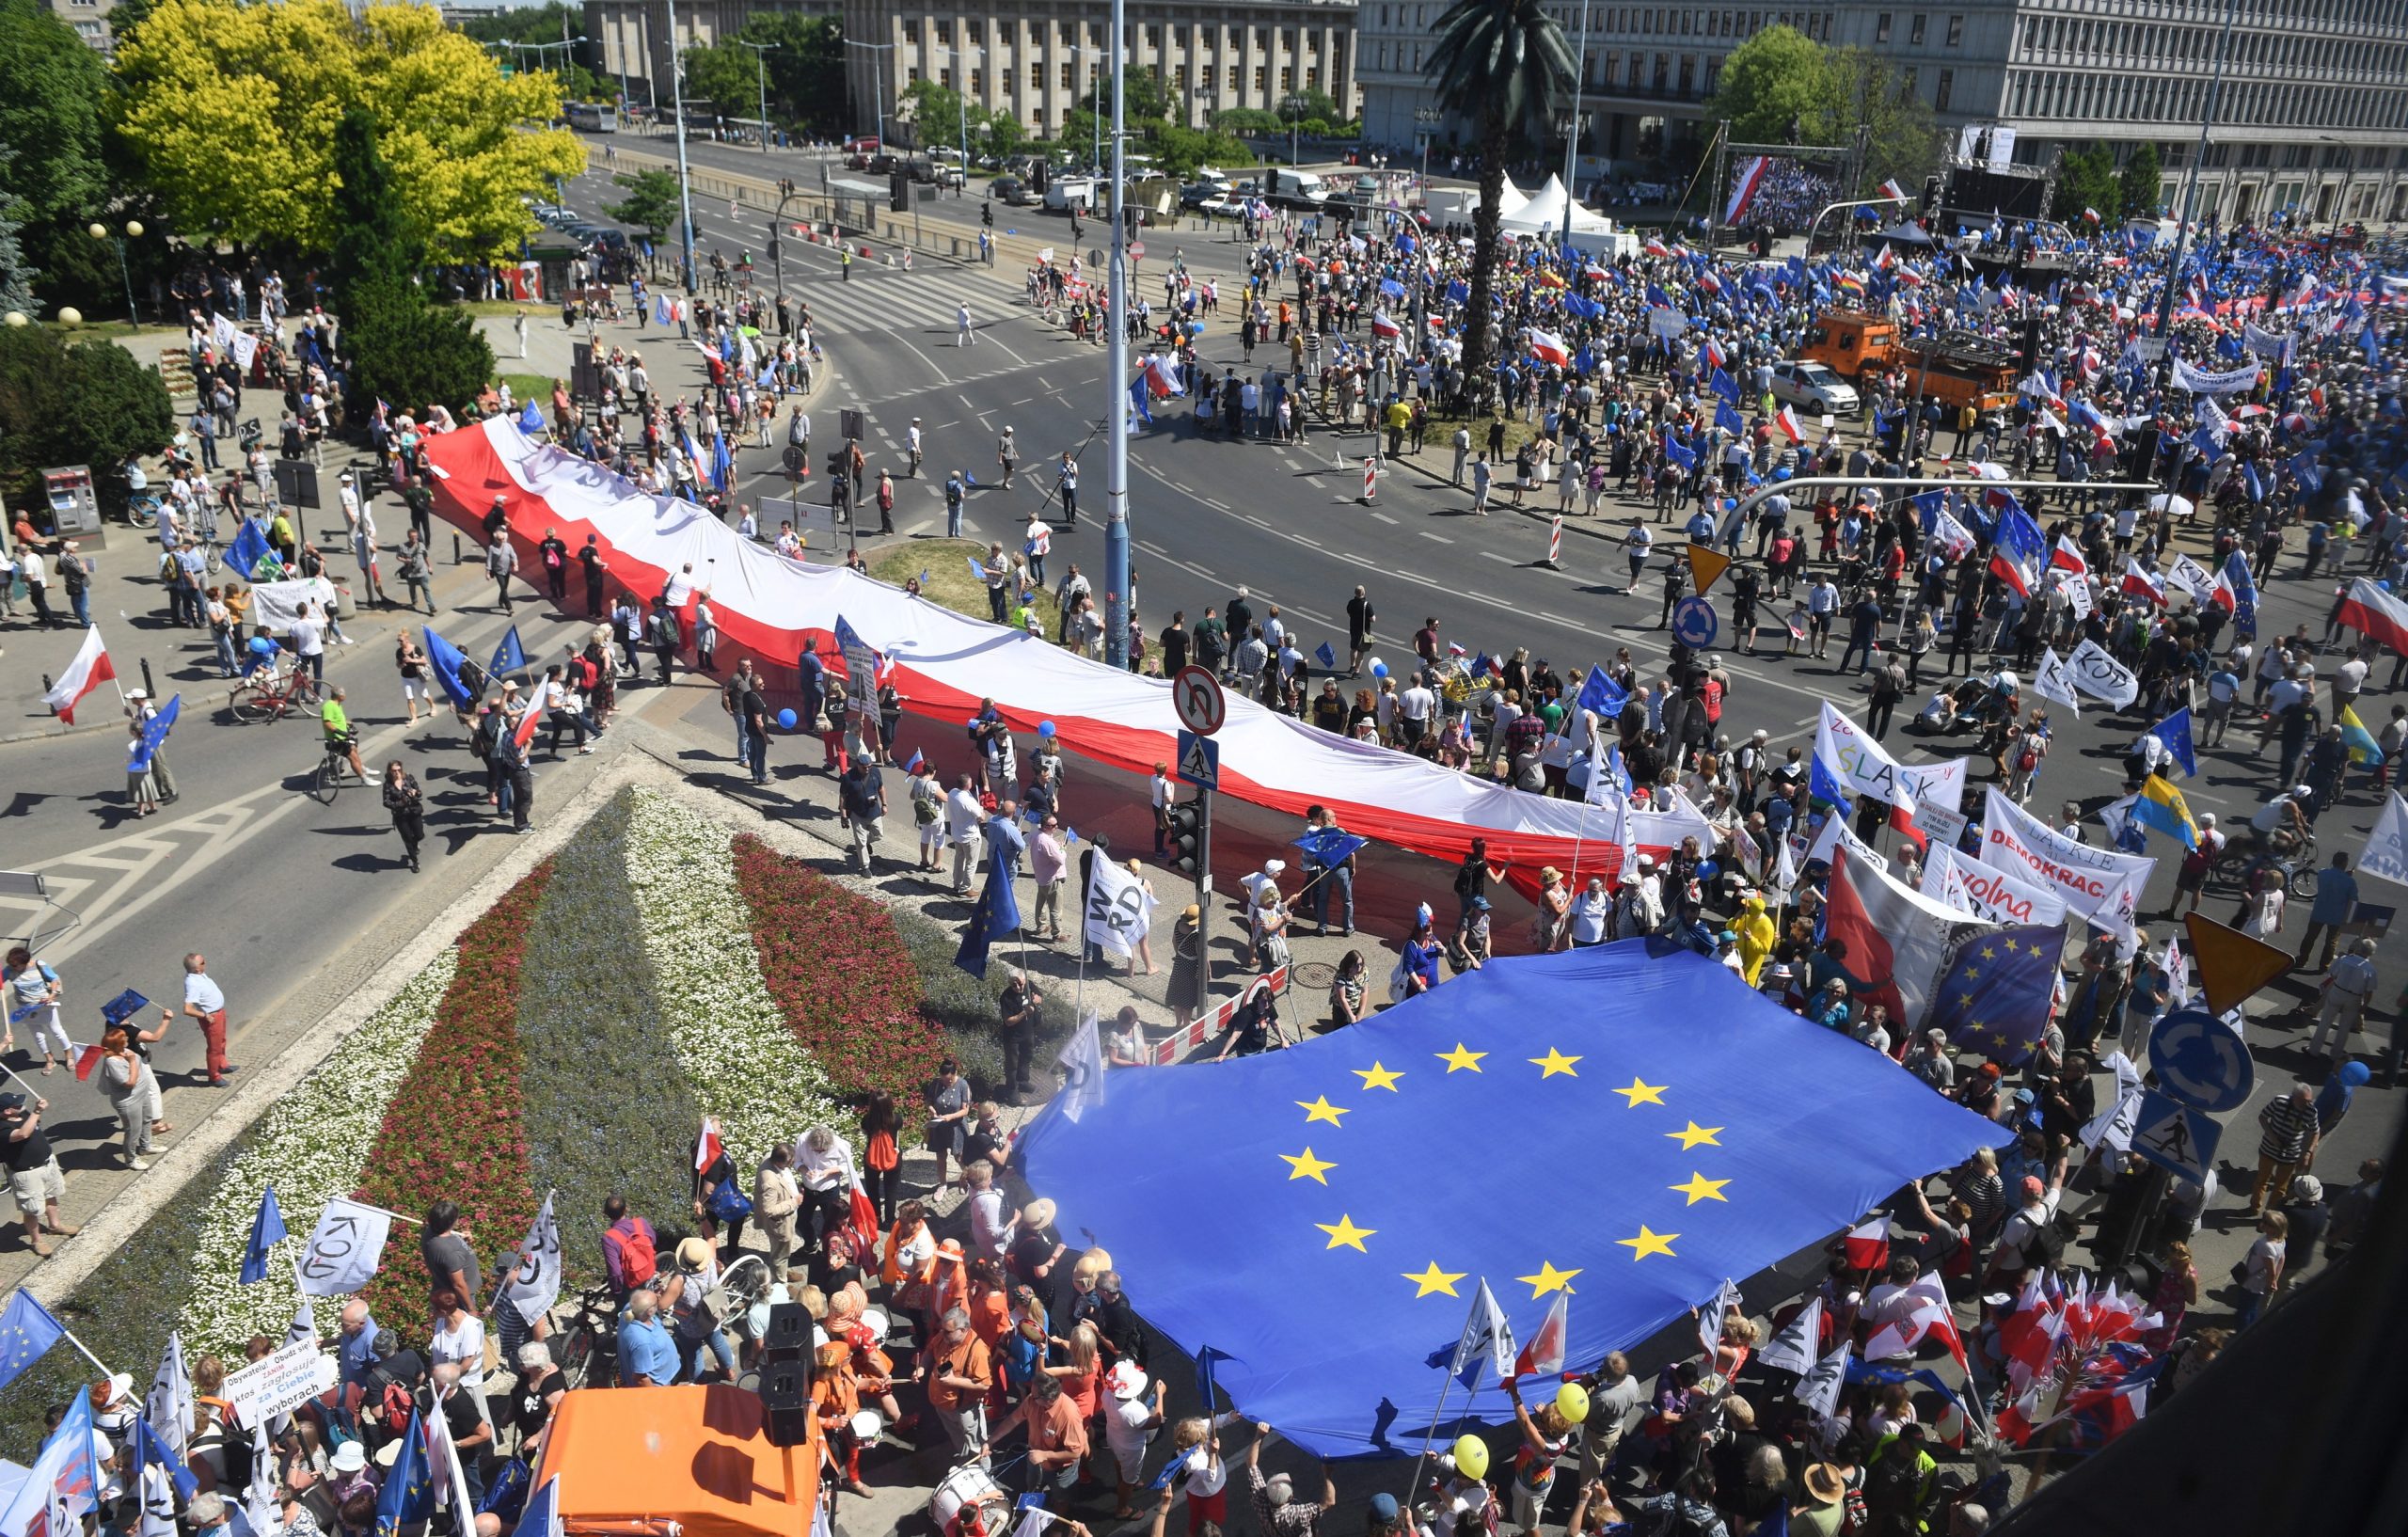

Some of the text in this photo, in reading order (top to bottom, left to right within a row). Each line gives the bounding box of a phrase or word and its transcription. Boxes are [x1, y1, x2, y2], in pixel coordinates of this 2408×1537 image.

[2077, 650, 2129, 689] KOD
[1836, 743, 1935, 800] ŚLĄSK
[228, 1361, 269, 1387] Obywatelu!
[257, 1370, 316, 1404] za Ciebie
[261, 1363, 286, 1380] ZANIM
[234, 1387, 256, 1404] ktoś
[265, 1383, 321, 1417] wyborach
